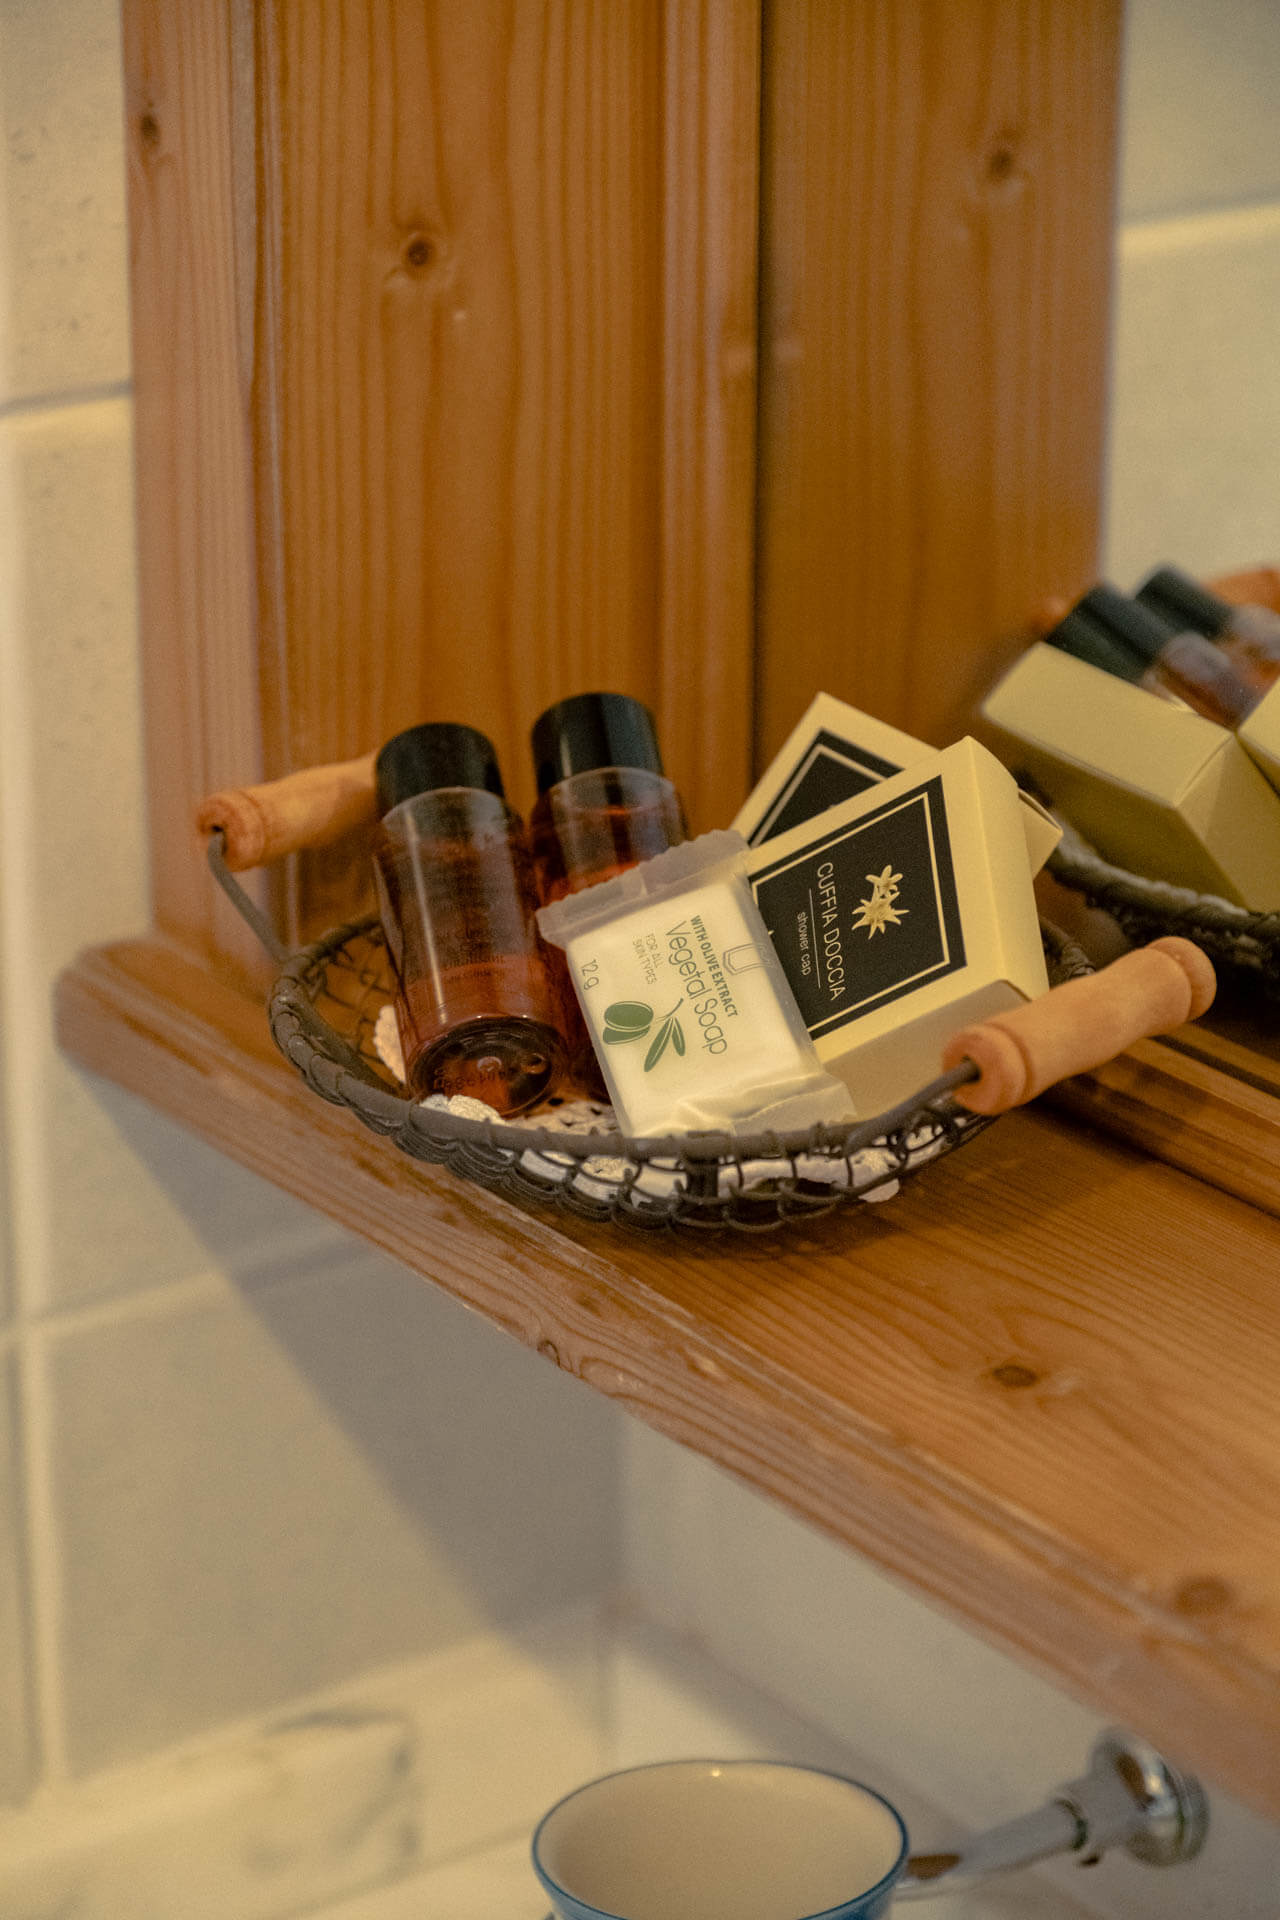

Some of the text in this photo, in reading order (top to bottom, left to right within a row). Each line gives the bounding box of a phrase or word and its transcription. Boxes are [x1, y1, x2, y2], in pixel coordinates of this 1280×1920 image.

[632, 938, 657, 985] SKIN TYPES
[645, 933, 663, 968] FOR ALL
[796, 911, 812, 976] shower cap
[817, 862, 846, 1001] CUFFIA DOCCIA
[581, 959, 600, 991] 12 g
[665, 920, 728, 1055] Vegetal Soap
[690, 915, 738, 1018] WITH OLIVE EXTRACT
